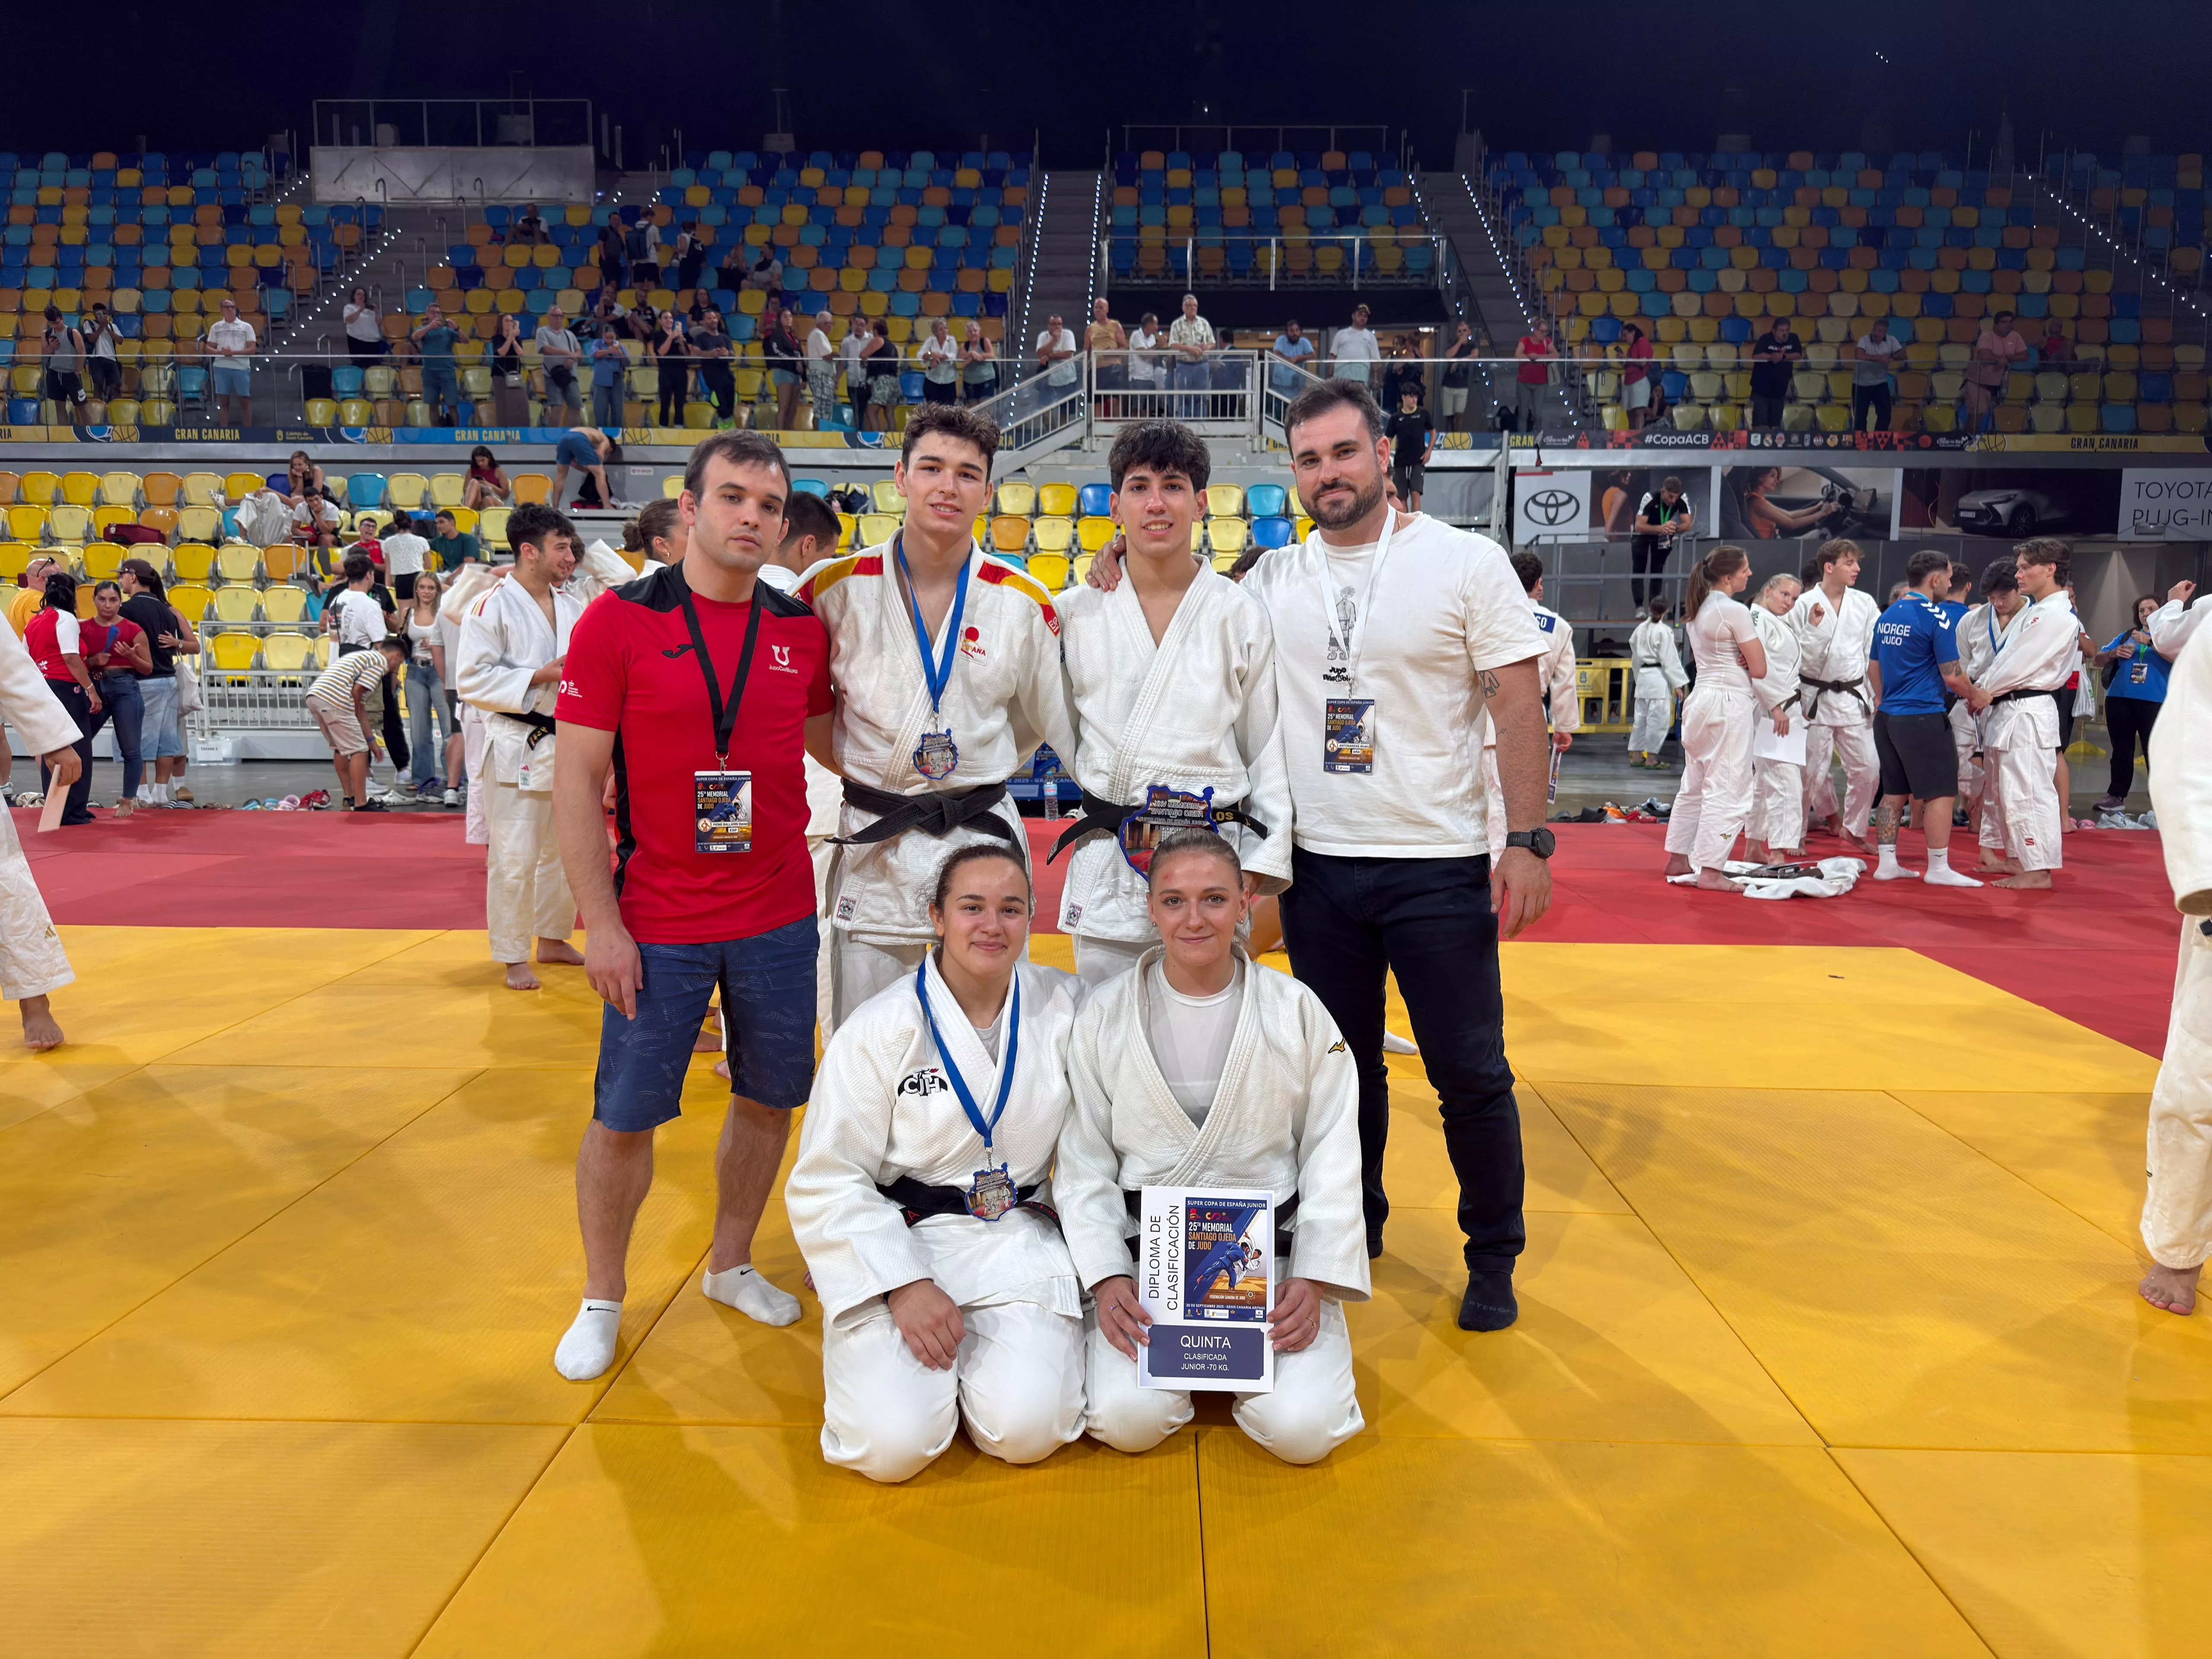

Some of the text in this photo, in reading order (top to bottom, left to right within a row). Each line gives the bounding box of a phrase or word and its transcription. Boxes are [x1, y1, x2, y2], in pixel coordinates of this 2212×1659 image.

[175, 429, 240, 440] GRAN CANARIA
[455, 430, 479, 441] GRAN
[1644, 434, 1709, 447] #CopaACB
[1510, 435, 1535, 447] GRAN
[2071, 437, 2139, 449] GRAN CANARIA
[1877, 623, 1911, 637] NORGE
[1881, 636, 1902, 646] JUDO
[904, 1077, 941, 1096] CJH
[1150, 1215, 1161, 1232] DE
[1202, 1223, 1233, 1232] MEMORIAL
[1189, 1232, 1236, 1242] SANTIAGO OJEDA
[1188, 1241, 1211, 1250] DE JUDO
[1167, 1205, 1179, 1310] CLASIFICACIÓN
[1149, 1237, 1160, 1299] DIPLOMA
[1180, 1335, 1231, 1349] QUINTA
